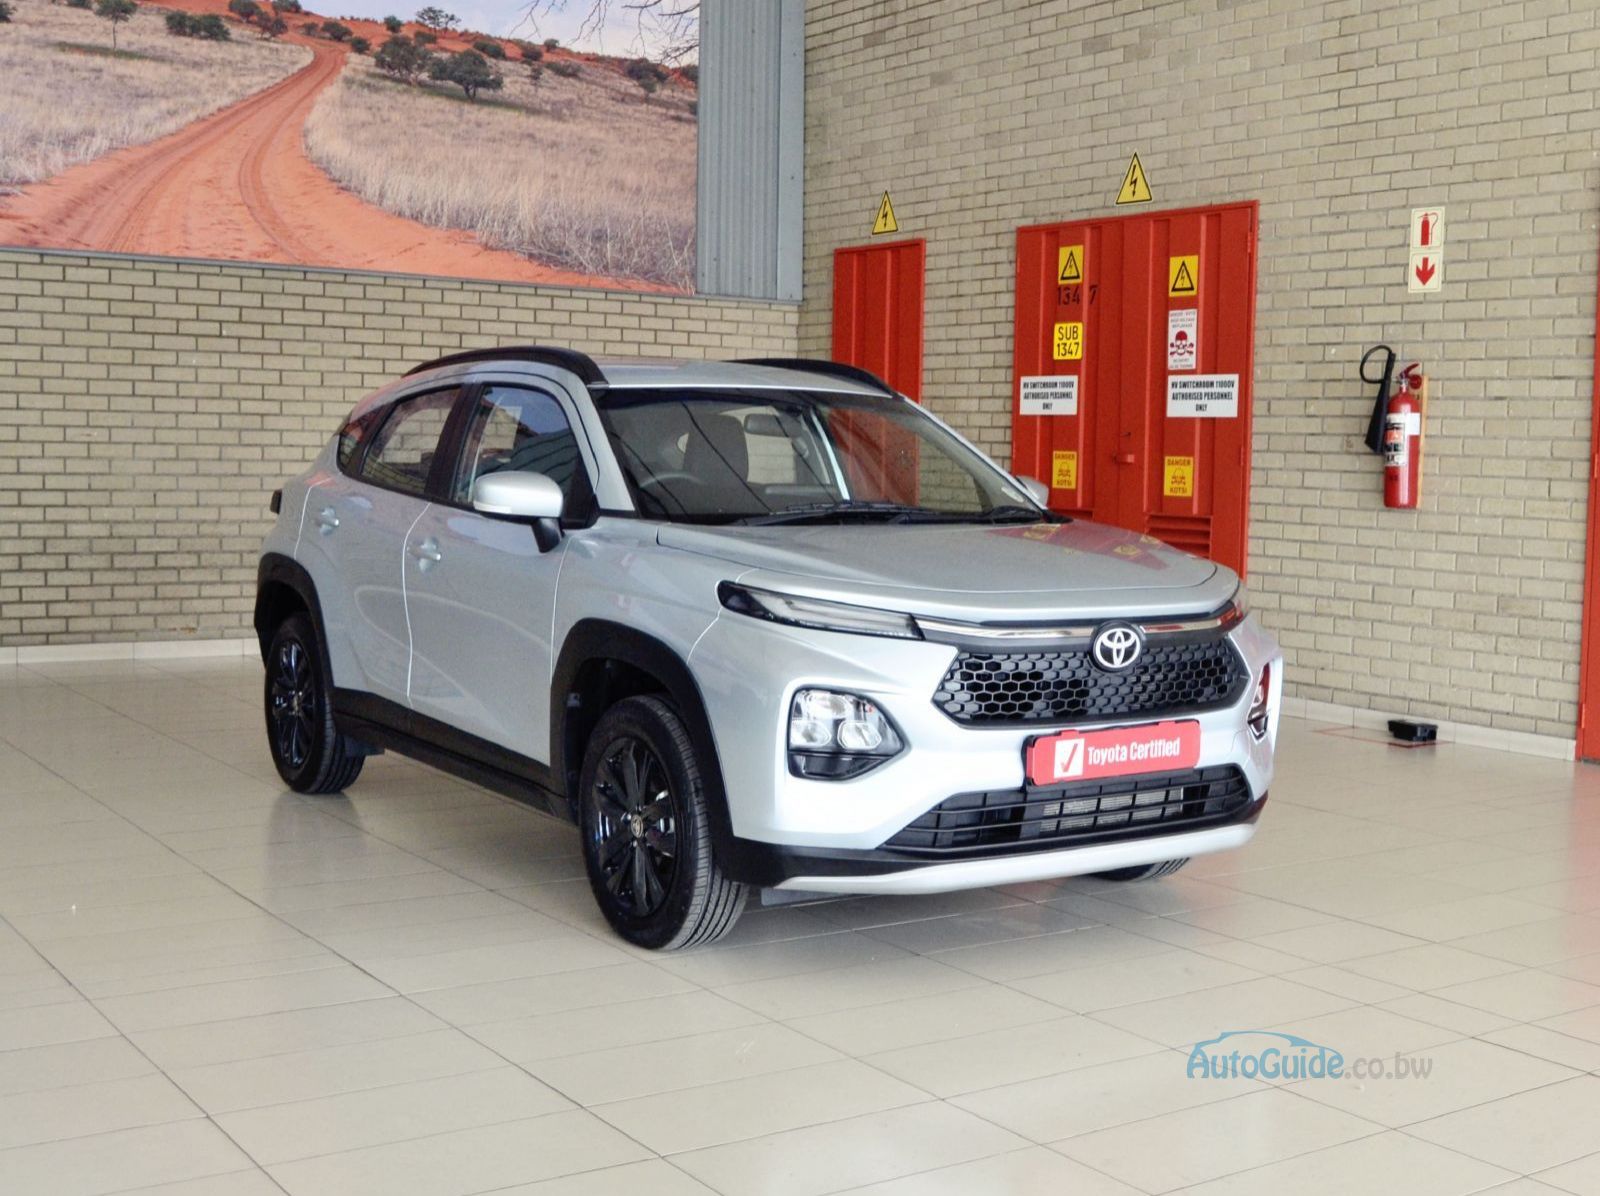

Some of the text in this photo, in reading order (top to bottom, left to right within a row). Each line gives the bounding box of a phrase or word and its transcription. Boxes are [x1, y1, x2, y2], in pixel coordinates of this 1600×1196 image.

[1058, 325, 1079, 341] SUB
[1056, 342, 1080, 357] 1347
[1179, 381, 1214, 389] SWITCHROOM
[1216, 380, 1235, 389] 11000V
[1024, 391, 1073, 400] AUTHORISED PERSONNEL
[1172, 391, 1233, 401] AUTHORISED PERSONNEL
[1195, 403, 1208, 412] ONLY
[1167, 458, 1191, 466] DANGER
[1087, 737, 1181, 766] Toyota Certified
